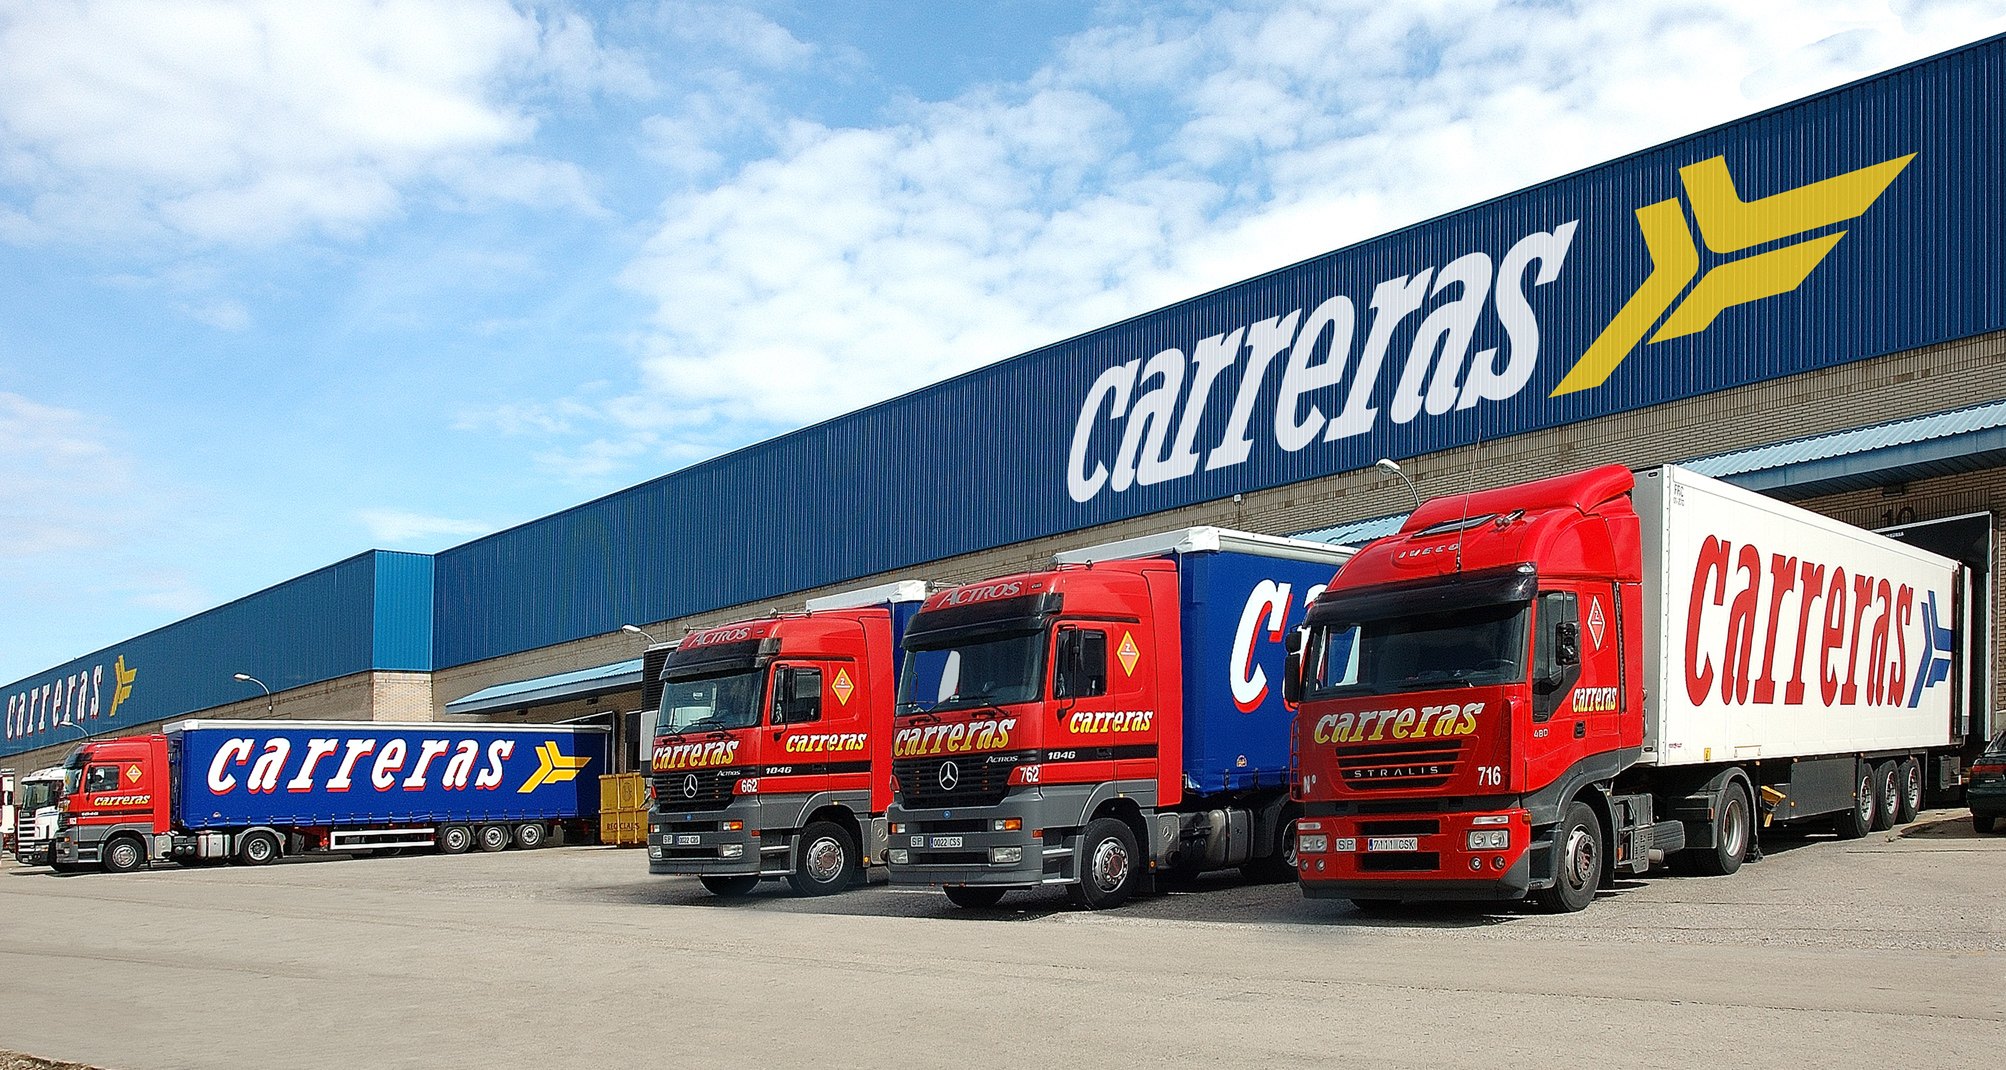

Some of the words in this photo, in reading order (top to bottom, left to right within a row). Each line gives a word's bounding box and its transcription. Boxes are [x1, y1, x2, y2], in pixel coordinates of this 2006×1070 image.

[1067, 219, 1580, 503] carreras
[1398, 543, 1459, 559] IVECO
[1684, 534, 1914, 708] carreras
[6, 665, 103, 741] carreras
[1572, 686, 1618, 713] carreras
[1069, 710, 1154, 735] carreras
[1313, 702, 1486, 745] carreras
[785, 732, 868, 753] carreras
[894, 717, 1017, 758] carreras
[652, 739, 740, 771] carreras
[207, 737, 515, 795] carreras
[1019, 765, 1040, 783] 762
[1354, 765, 1440, 778] STRALIS
[1477, 766, 1502, 786] 716
[741, 778, 758, 793] 662
[94, 794, 151, 807] carreras
[911, 837, 922, 846] SP
[1338, 840, 1354, 850] SP
[1373, 840, 1394, 850] 7111
[1398, 840, 1415, 850] CSK
